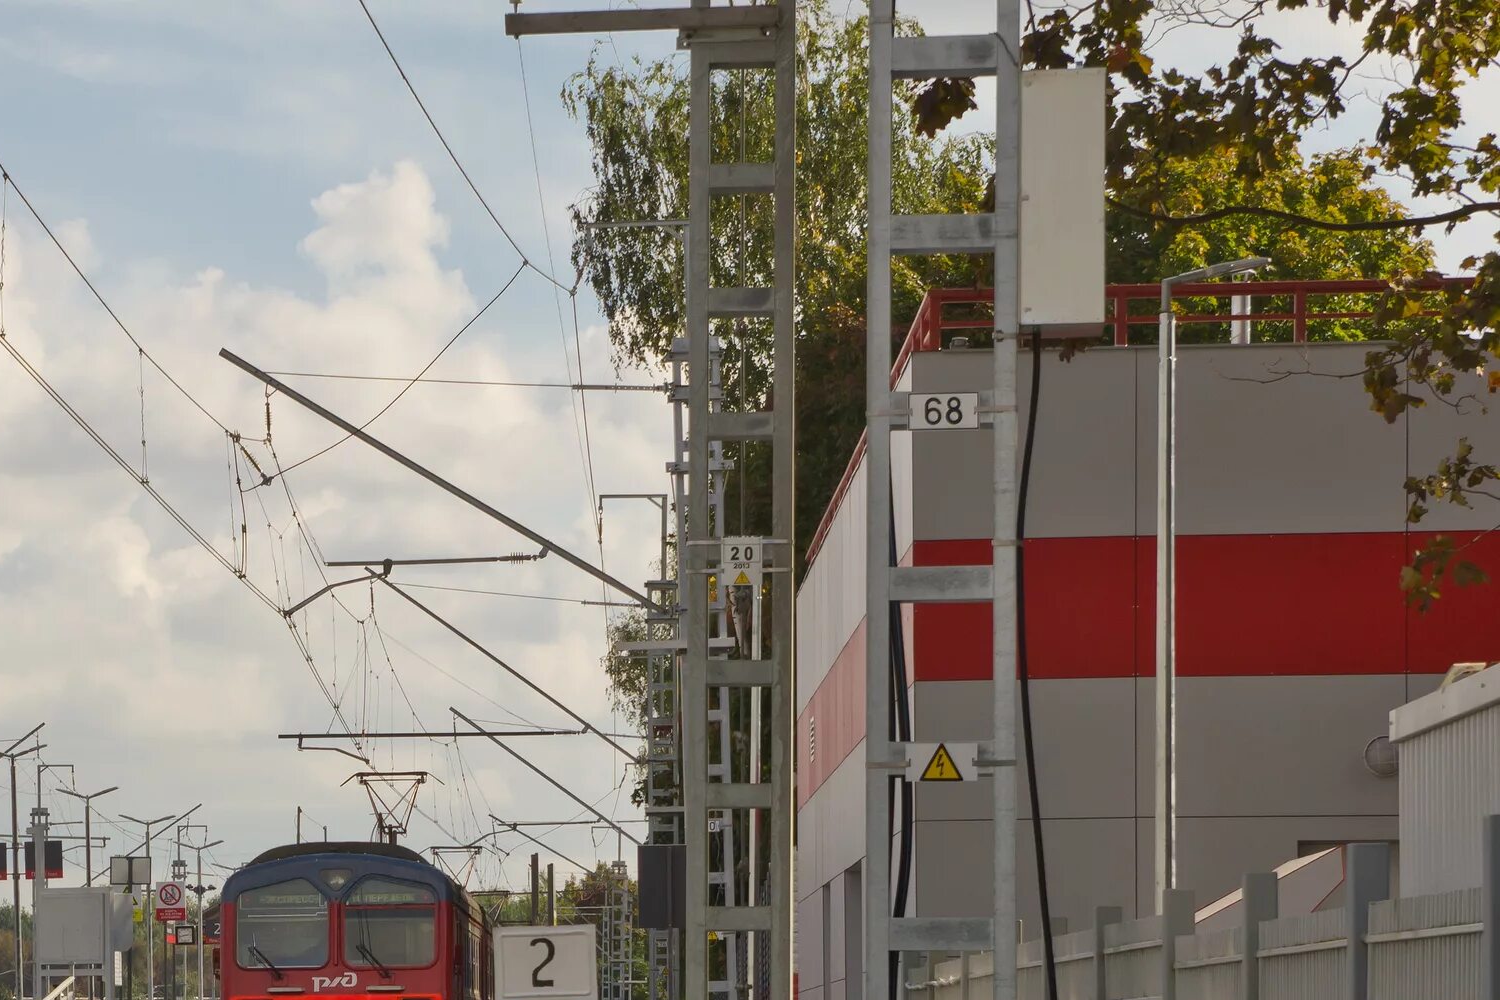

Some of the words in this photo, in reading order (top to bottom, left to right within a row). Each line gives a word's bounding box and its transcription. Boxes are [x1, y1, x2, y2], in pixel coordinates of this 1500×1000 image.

[924, 396, 963, 425] 68
[730, 546, 753, 561] 20
[530, 937, 555, 988] 2
